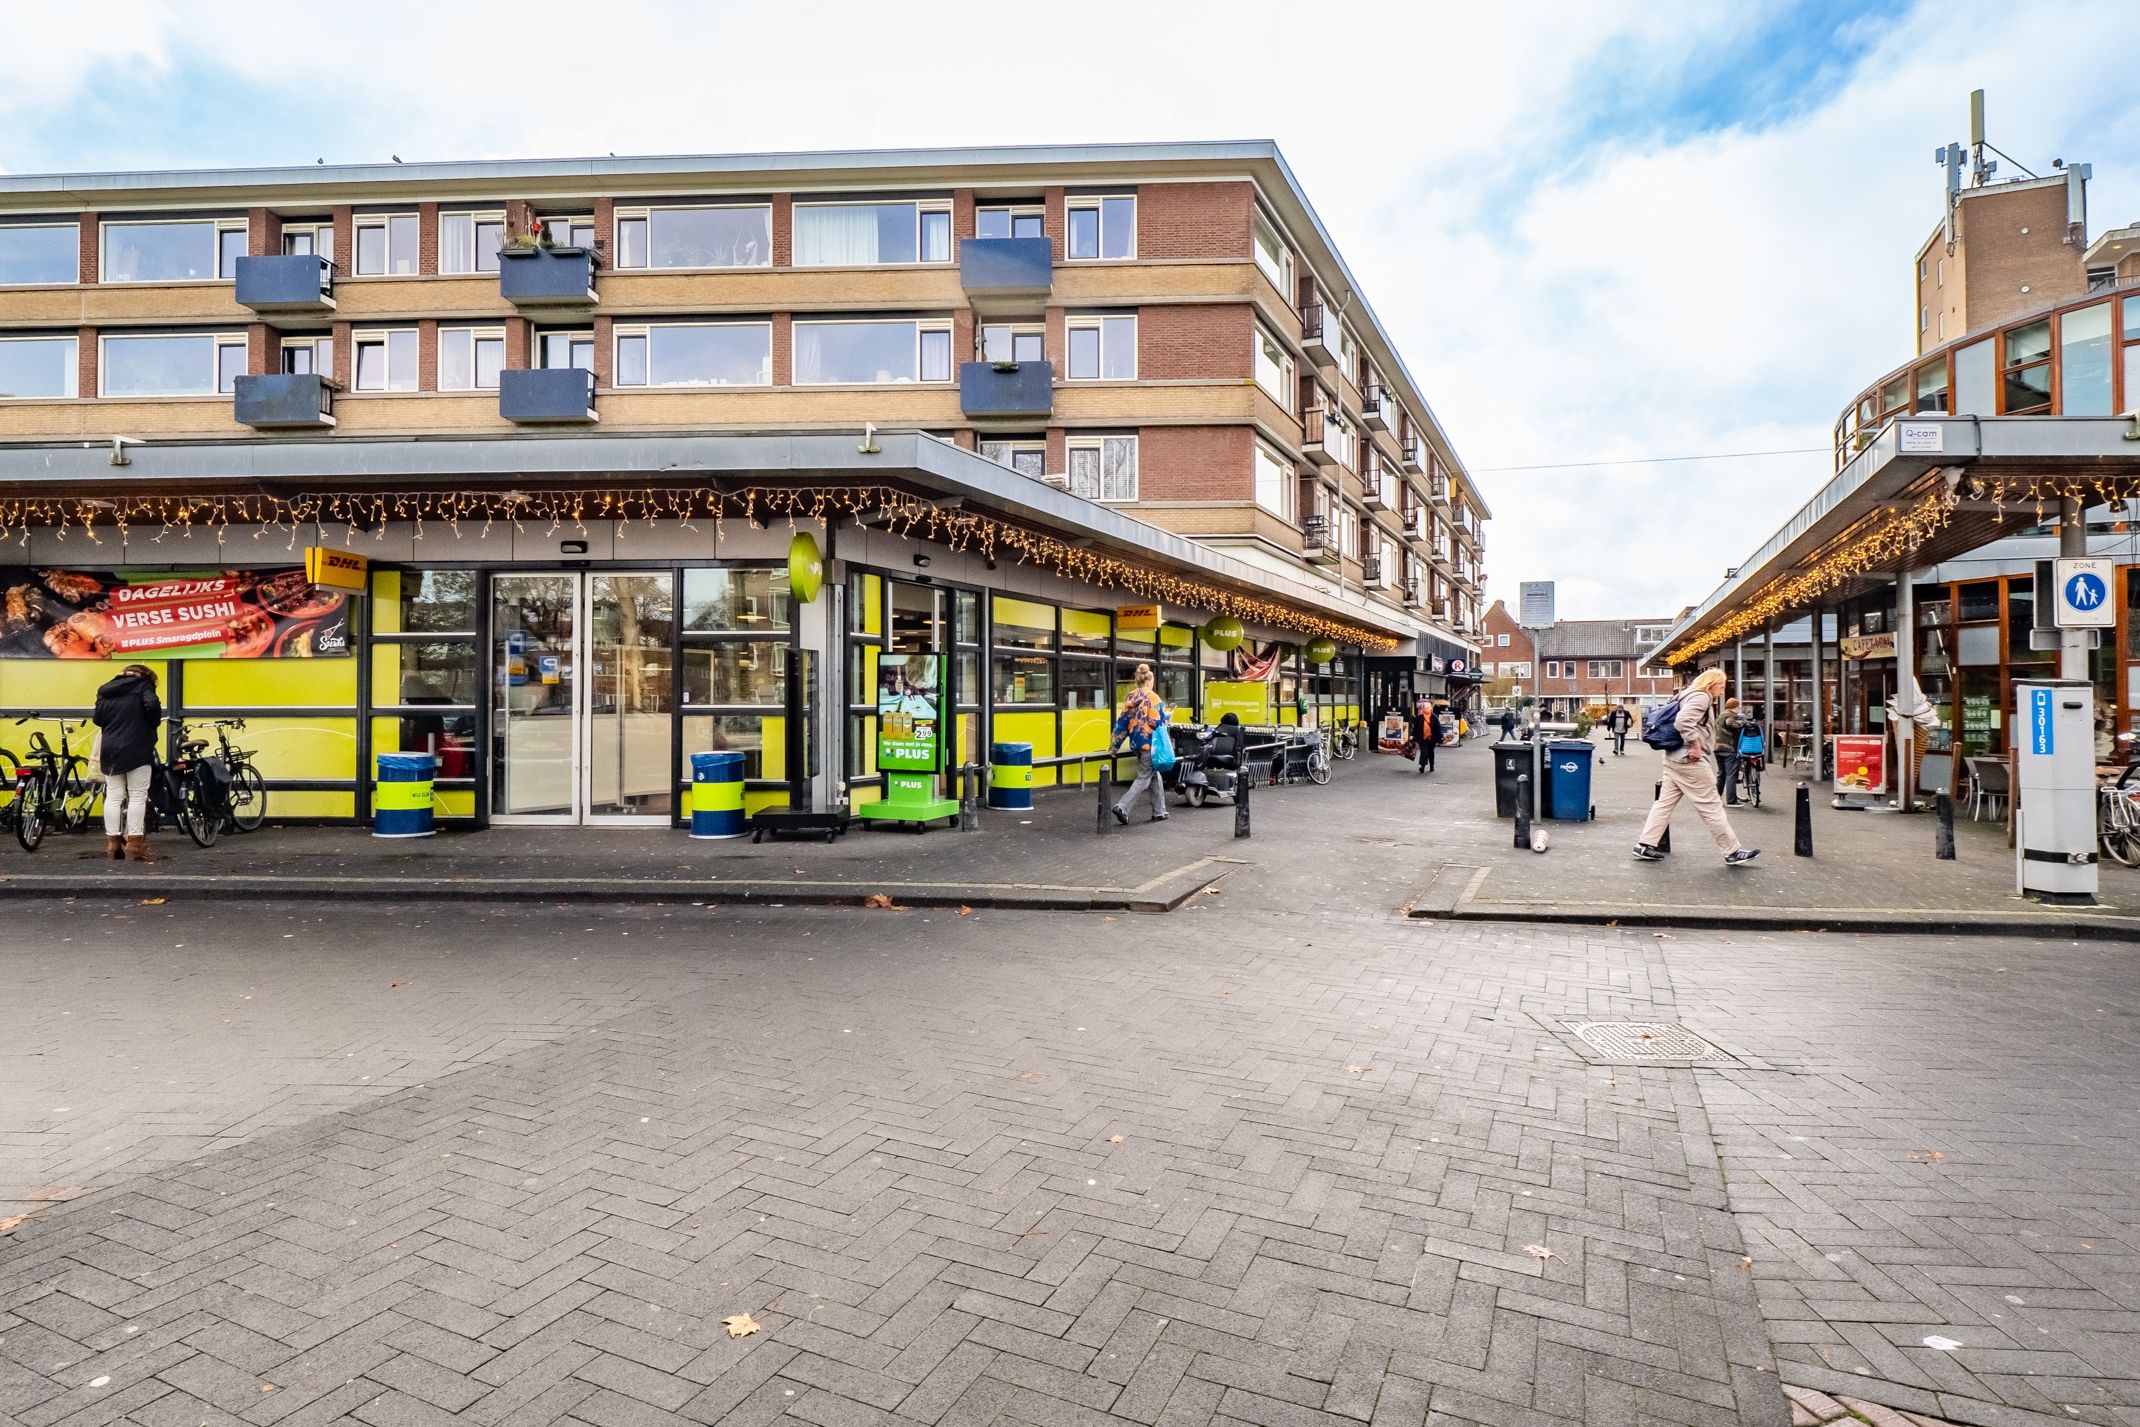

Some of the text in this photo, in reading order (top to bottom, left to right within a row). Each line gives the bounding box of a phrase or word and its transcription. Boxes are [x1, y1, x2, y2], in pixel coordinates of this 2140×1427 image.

[1906, 430, 1937, 438] Q-cam
[328, 556, 361, 570] DHL
[118, 580, 226, 602] DAGELIJKS
[112, 602, 236, 629] VERSE SUSHI
[1122, 609, 1152, 617] DHL
[129, 630, 222, 647] PLUS Smaragdplein
[1213, 629, 1238, 638] PLUS
[2038, 707, 2046, 753] 30163
[895, 748, 930, 760] PLUS
[900, 781, 922, 789] PLUS
